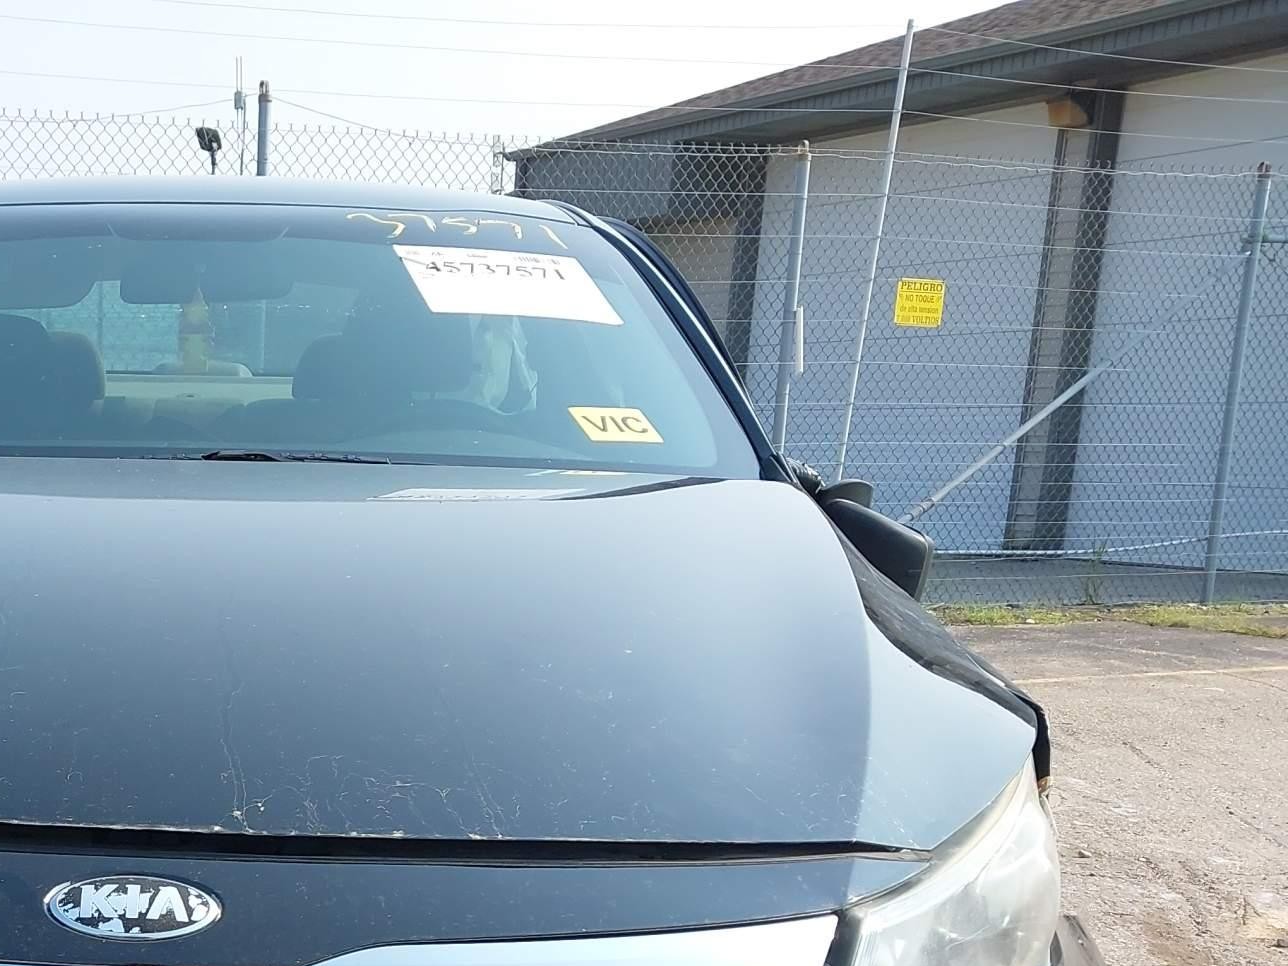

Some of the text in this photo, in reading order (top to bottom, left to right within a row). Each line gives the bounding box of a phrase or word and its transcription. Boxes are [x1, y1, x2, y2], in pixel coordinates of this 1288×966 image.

[900, 281, 943, 292] PELIGRO
[905, 294, 914, 303] NO
[580, 414, 650, 434] VIC
[78, 883, 190, 923] KIA
